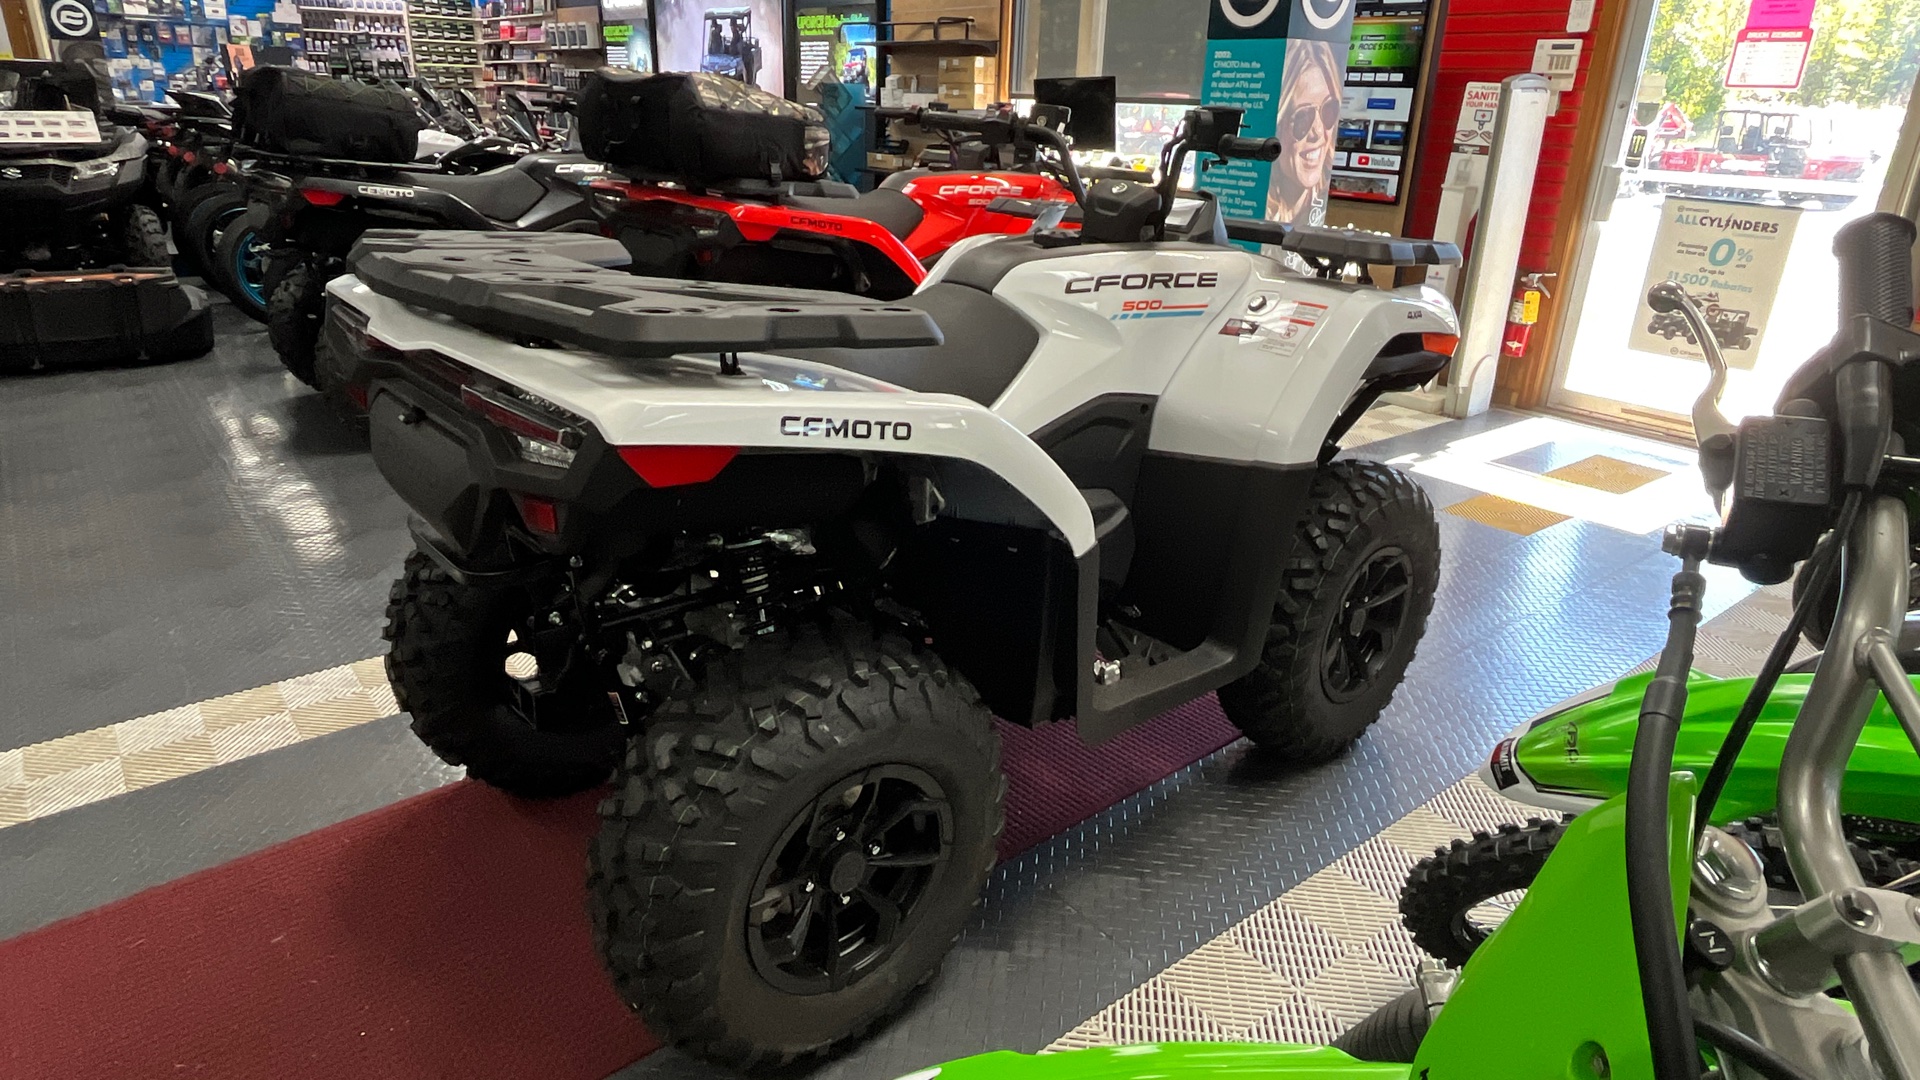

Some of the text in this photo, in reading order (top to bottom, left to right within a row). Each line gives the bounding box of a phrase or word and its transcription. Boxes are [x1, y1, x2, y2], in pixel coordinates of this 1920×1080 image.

[1249, 81, 1262, 89] and
[1248, 92, 1270, 101] making
[1467, 91, 1499, 101] SANITI
[1371, 157, 1395, 167] YouTube
[939, 185, 1023, 196] CFORCE
[790, 215, 843, 231] CFMOTO
[1065, 272, 1218, 294] CFORCE
[1711, 279, 1754, 294] Rebates
[1122, 300, 1162, 311] 500
[1680, 350, 1703, 358] CFMOT
[780, 415, 912, 441] CFMOTO
[1789, 437, 1803, 485] WARNING
